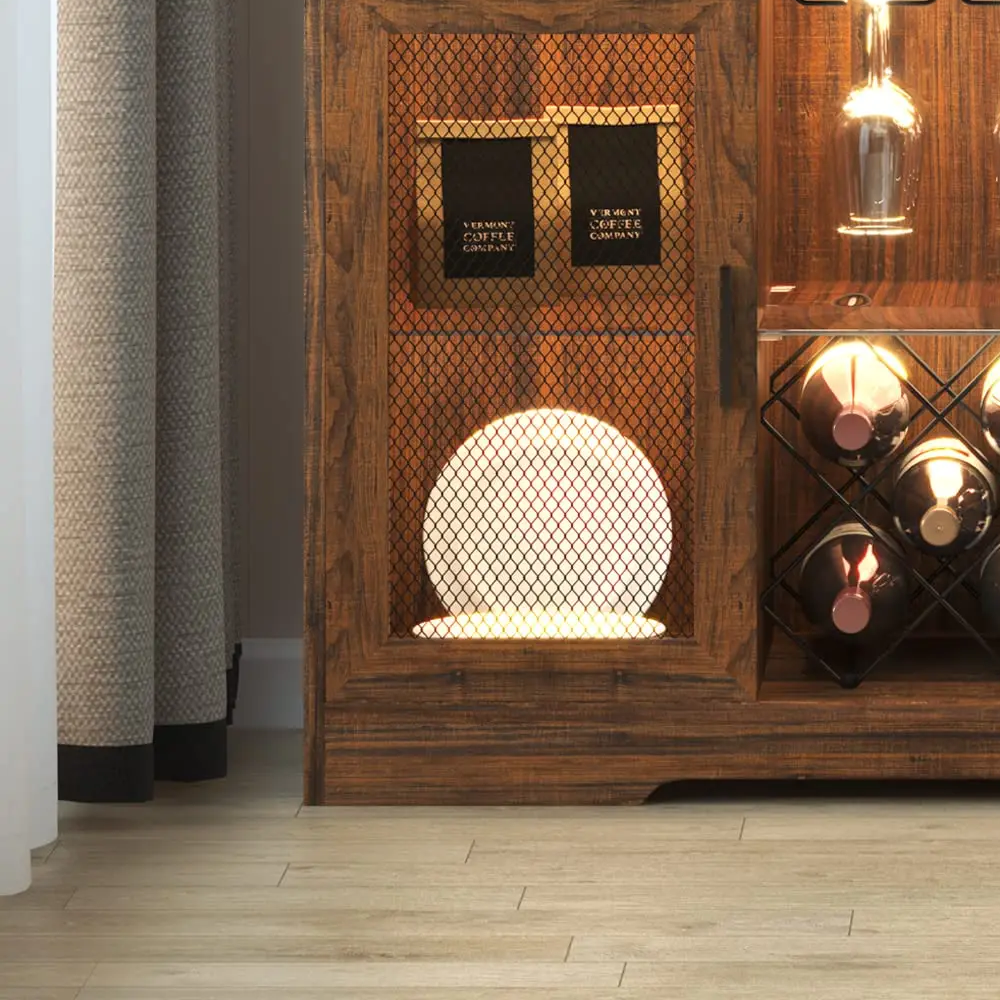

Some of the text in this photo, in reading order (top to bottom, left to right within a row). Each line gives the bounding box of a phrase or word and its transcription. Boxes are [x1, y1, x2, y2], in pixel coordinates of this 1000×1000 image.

[589, 219, 642, 230] COFFEE
[589, 231, 643, 241] COMPANY
[462, 243, 516, 253] COMPANY
